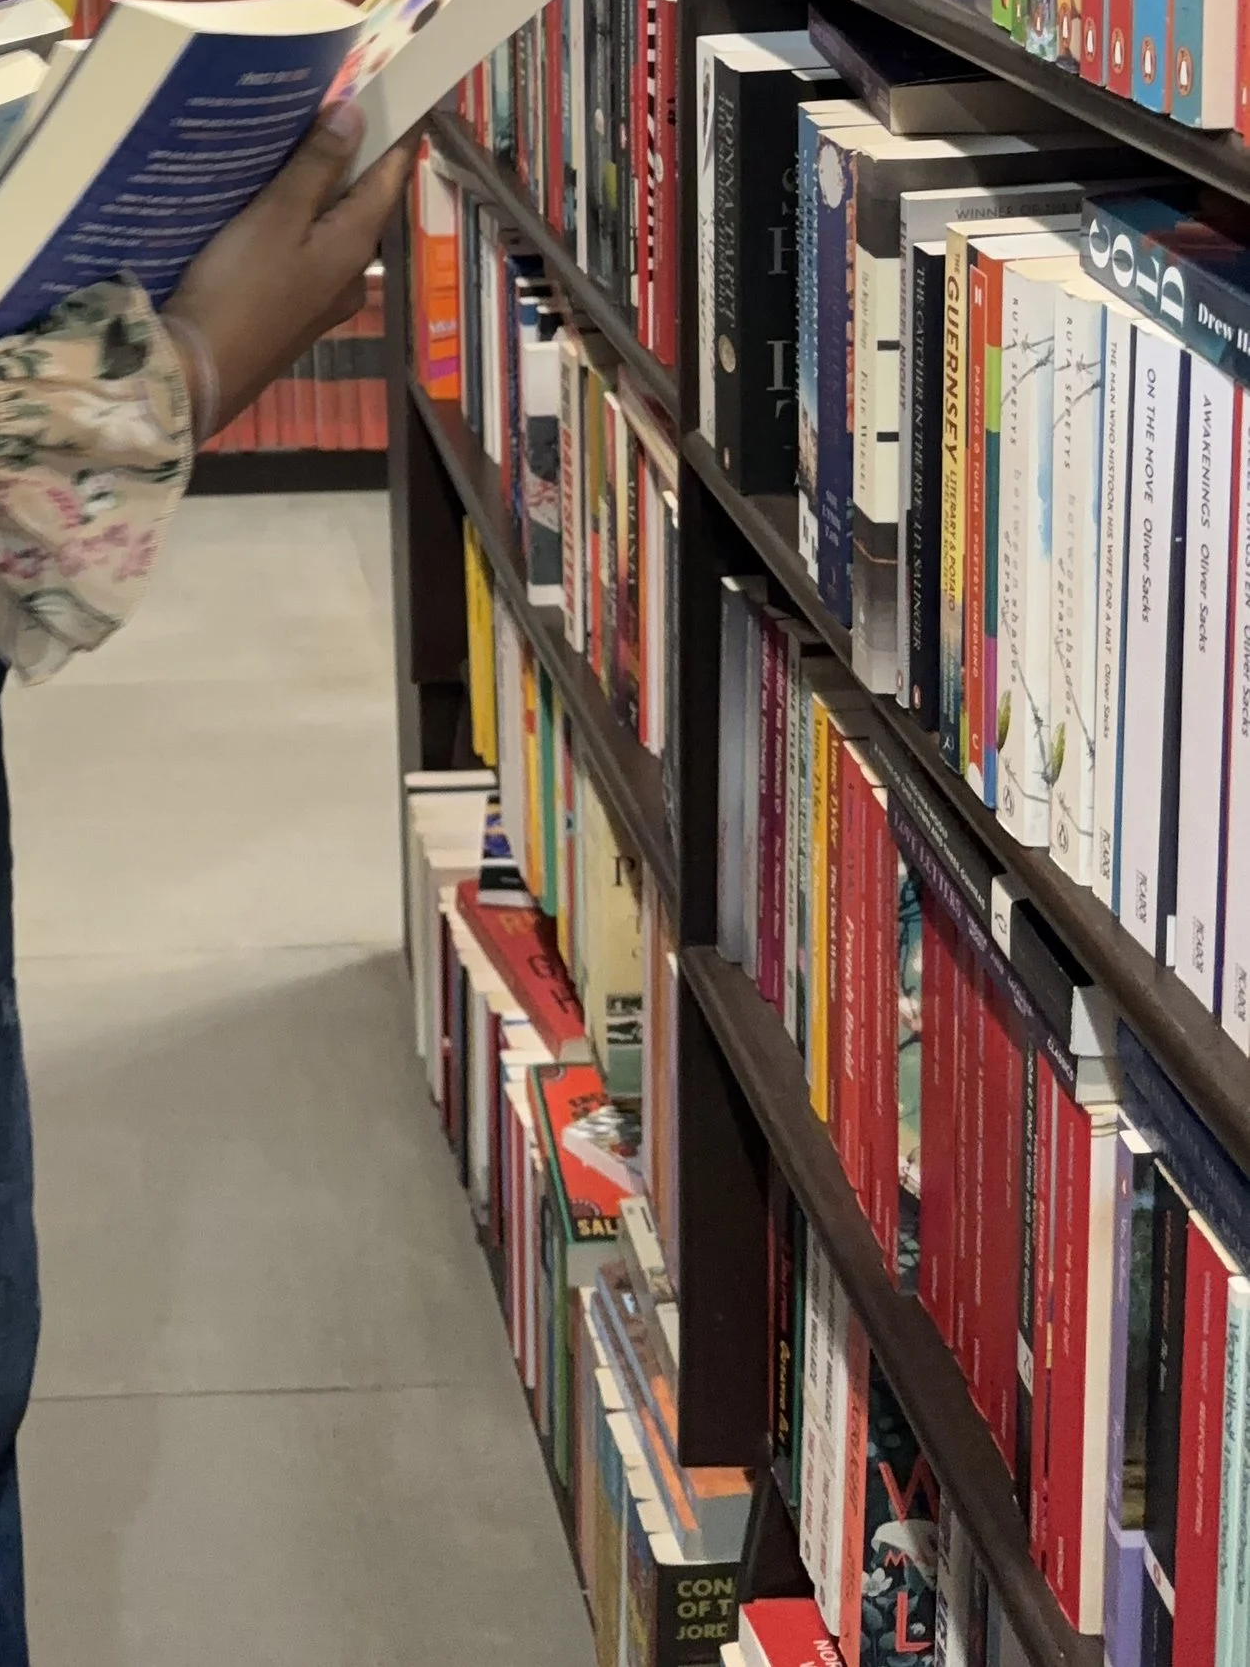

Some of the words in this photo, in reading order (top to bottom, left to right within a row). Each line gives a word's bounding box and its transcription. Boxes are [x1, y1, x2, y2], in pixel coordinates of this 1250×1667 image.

[1088, 217, 1186, 327] COLD
[914, 304, 925, 391] CATCHER
[1197, 301, 1233, 343] Drew
[944, 275, 961, 464] GUERNSEY
[1147, 366, 1157, 399] ON
[1146, 403, 1157, 445] THE
[1106, 447, 1116, 513] MISTOOK
[1143, 447, 1155, 505] MOVE
[1200, 393, 1212, 529] AWAKENINGS
[1141, 516, 1152, 570] Oliver
[1198, 542, 1210, 600] Oliver
[912, 555, 924, 651] SALINGER
[1140, 573, 1151, 624] Sacks
[1197, 600, 1209, 654] Sacks
[971, 601, 981, 679] UNBOUND
[843, 915, 854, 1002] French
[843, 1006, 854, 1080] Braid
